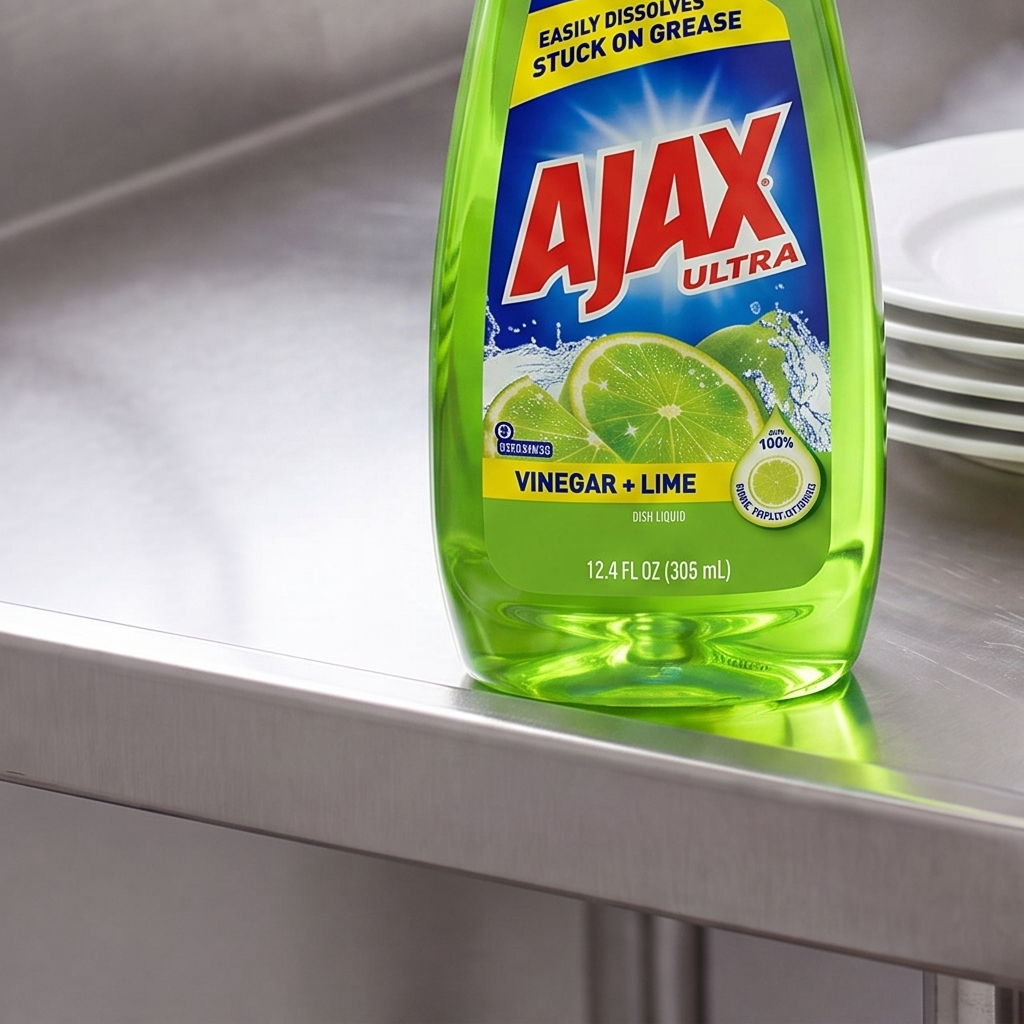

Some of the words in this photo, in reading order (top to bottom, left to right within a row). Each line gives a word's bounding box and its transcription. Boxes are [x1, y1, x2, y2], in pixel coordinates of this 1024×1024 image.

[532, 37, 607, 78] STUCK
[612, 27, 644, 53] ON
[650, 10, 743, 44] GREASE
[538, 15, 601, 49] EASILY
[508, 111, 786, 315] AJAX
[682, 242, 800, 290] ULTRA
[759, 436, 794, 450] 100%
[515, 470, 618, 495] VINEGAR
[622, 479, 636, 493] +
[641, 473, 697, 494] LIME
[632, 511, 654, 523] DISH
[656, 511, 686, 524] LIQUID
[586, 560, 618, 580] 12.4
[621, 561, 639, 580] FL
[642, 561, 661, 581] OZ
[702, 559, 732, 582] mL)
